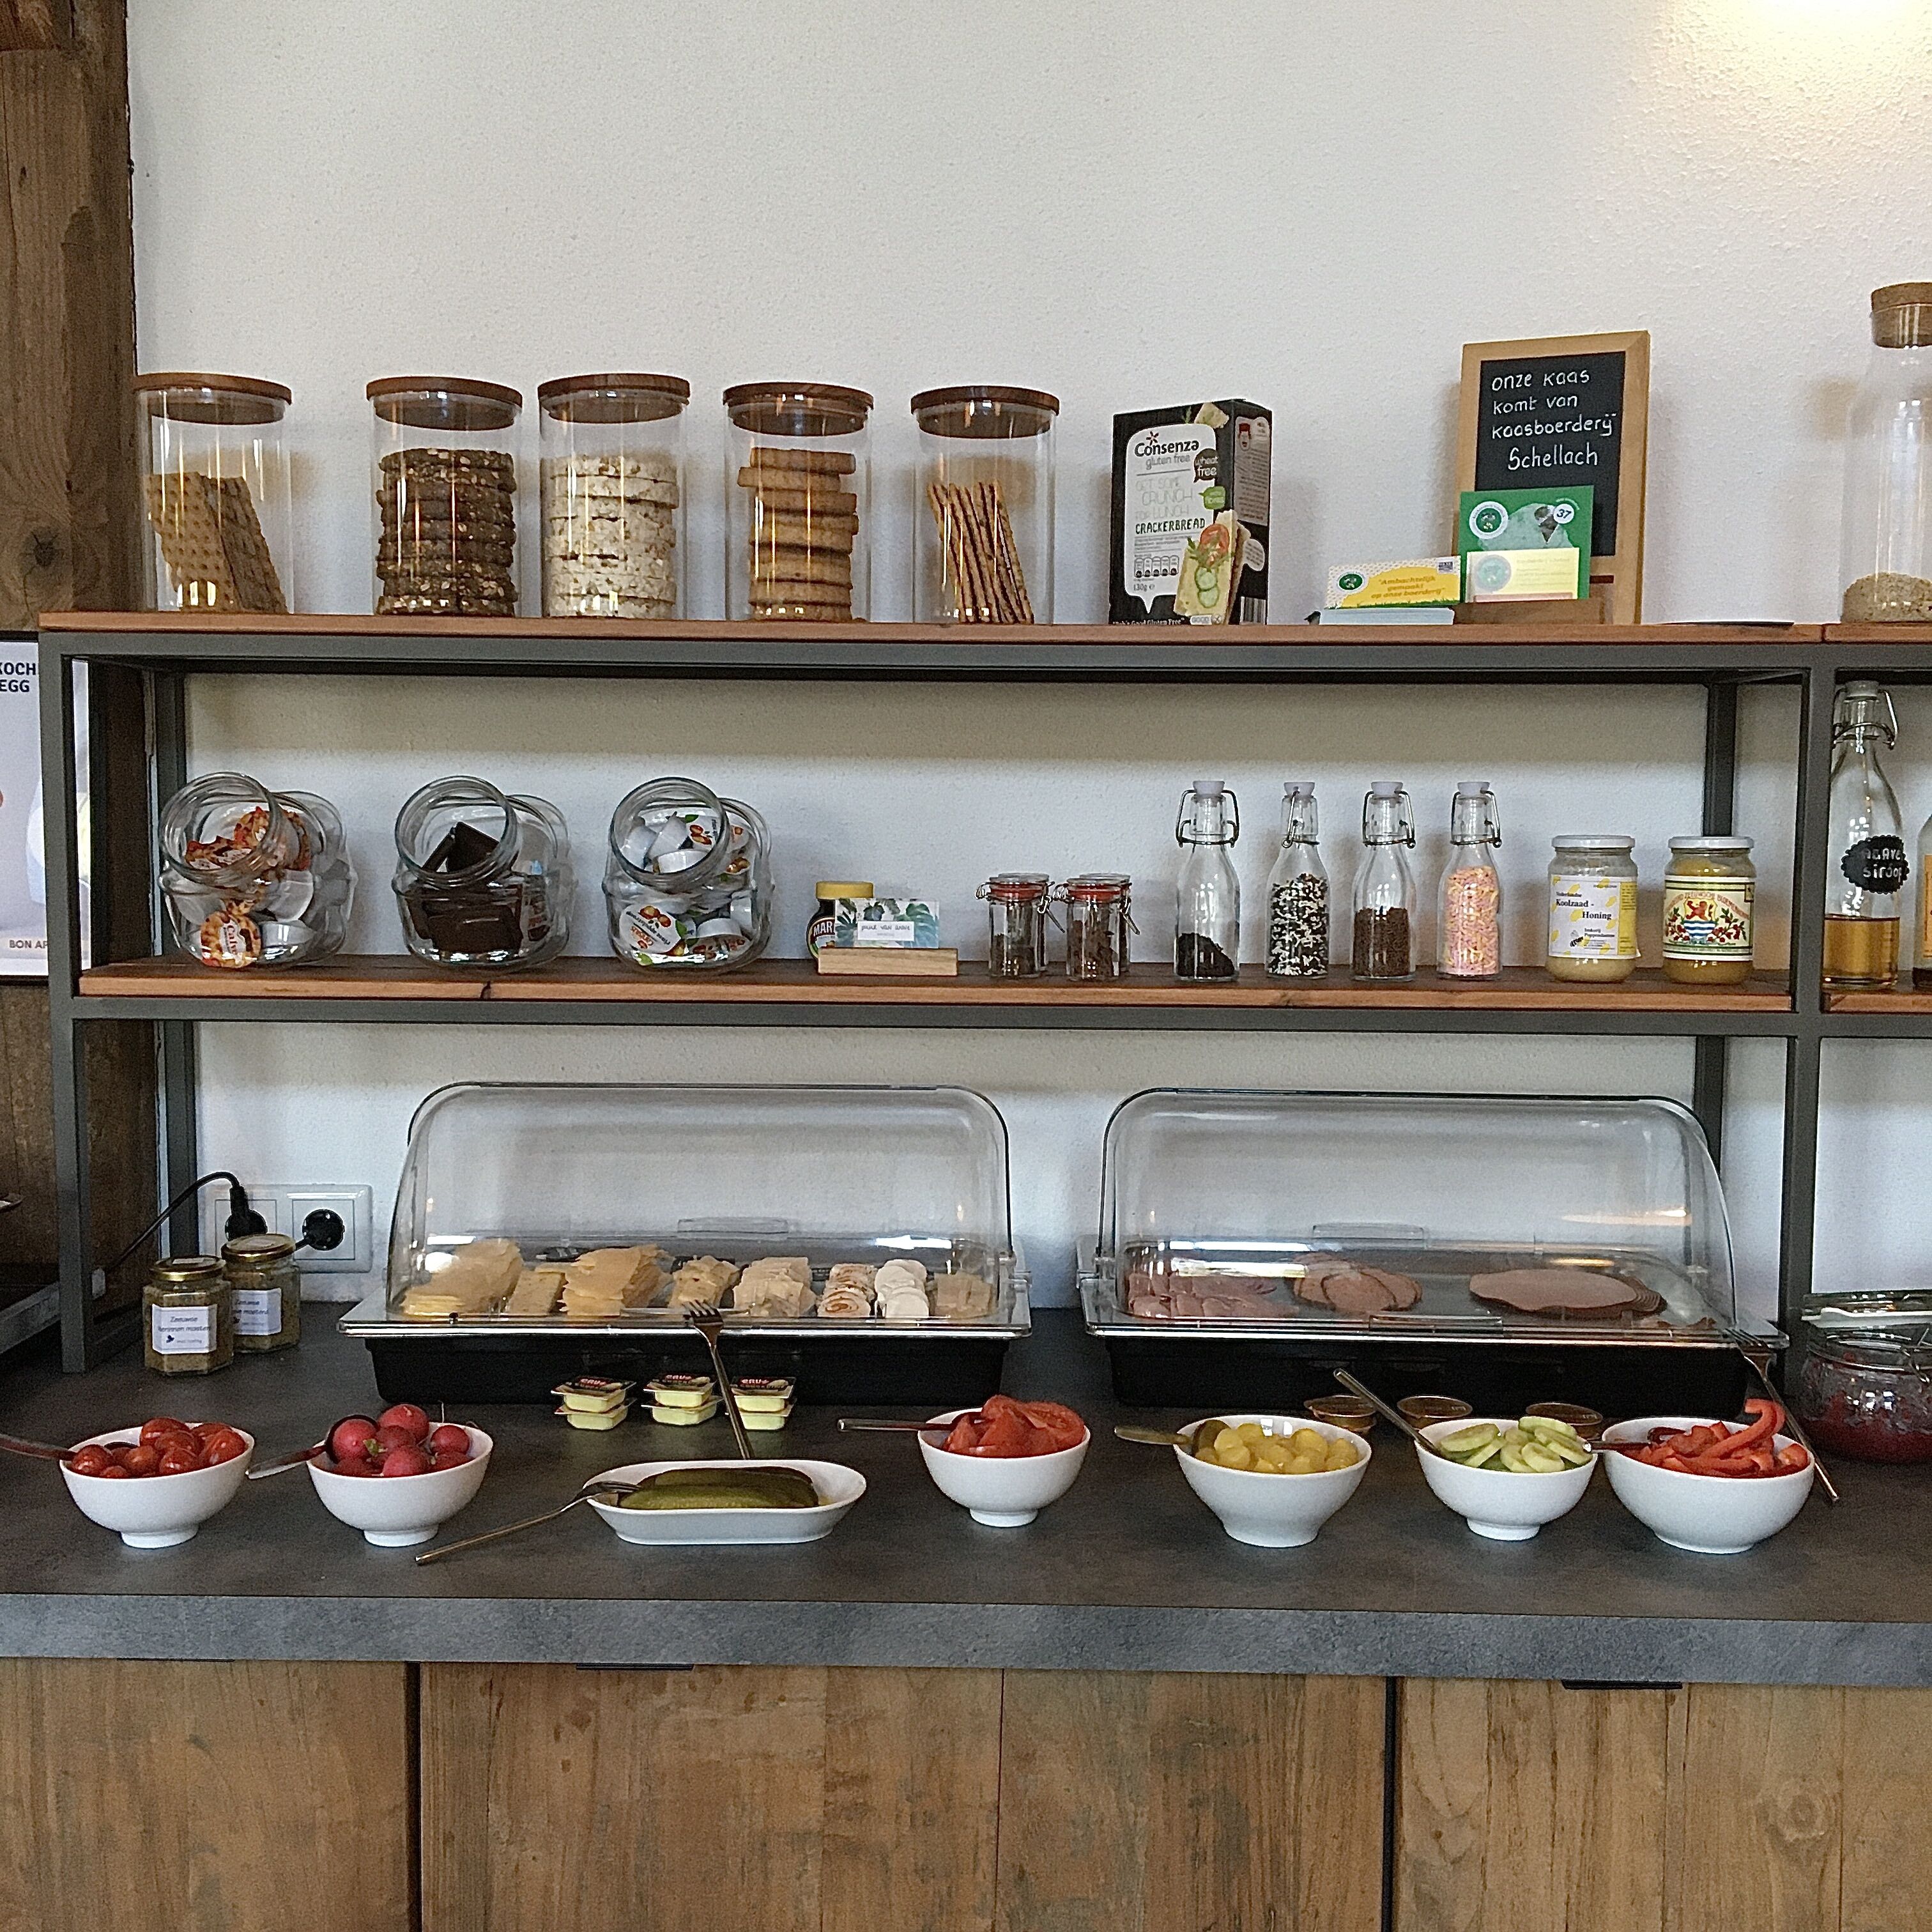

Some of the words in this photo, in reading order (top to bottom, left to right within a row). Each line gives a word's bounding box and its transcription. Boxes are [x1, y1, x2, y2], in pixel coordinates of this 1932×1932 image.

[1492, 373, 1532, 391] onze
[1493, 396, 1537, 415] komt
[1547, 395, 1577, 408] van
[1135, 440, 1199, 457] Consenza
[1146, 456, 1172, 470] gluten
[1174, 454, 1190, 463] free
[1508, 442, 1598, 470] Schellach
[1197, 466, 1217, 477] free
[1556, 509, 1572, 519] 37
[1135, 518, 1206, 535] CRACKERBREAD
[0, 662, 36, 676] OCH
[0, 679, 30, 693] EGG
[1556, 898, 1589, 907] Koolzaad
[1582, 911, 1612, 921] Honing
[9, 939, 32, 949] BON
